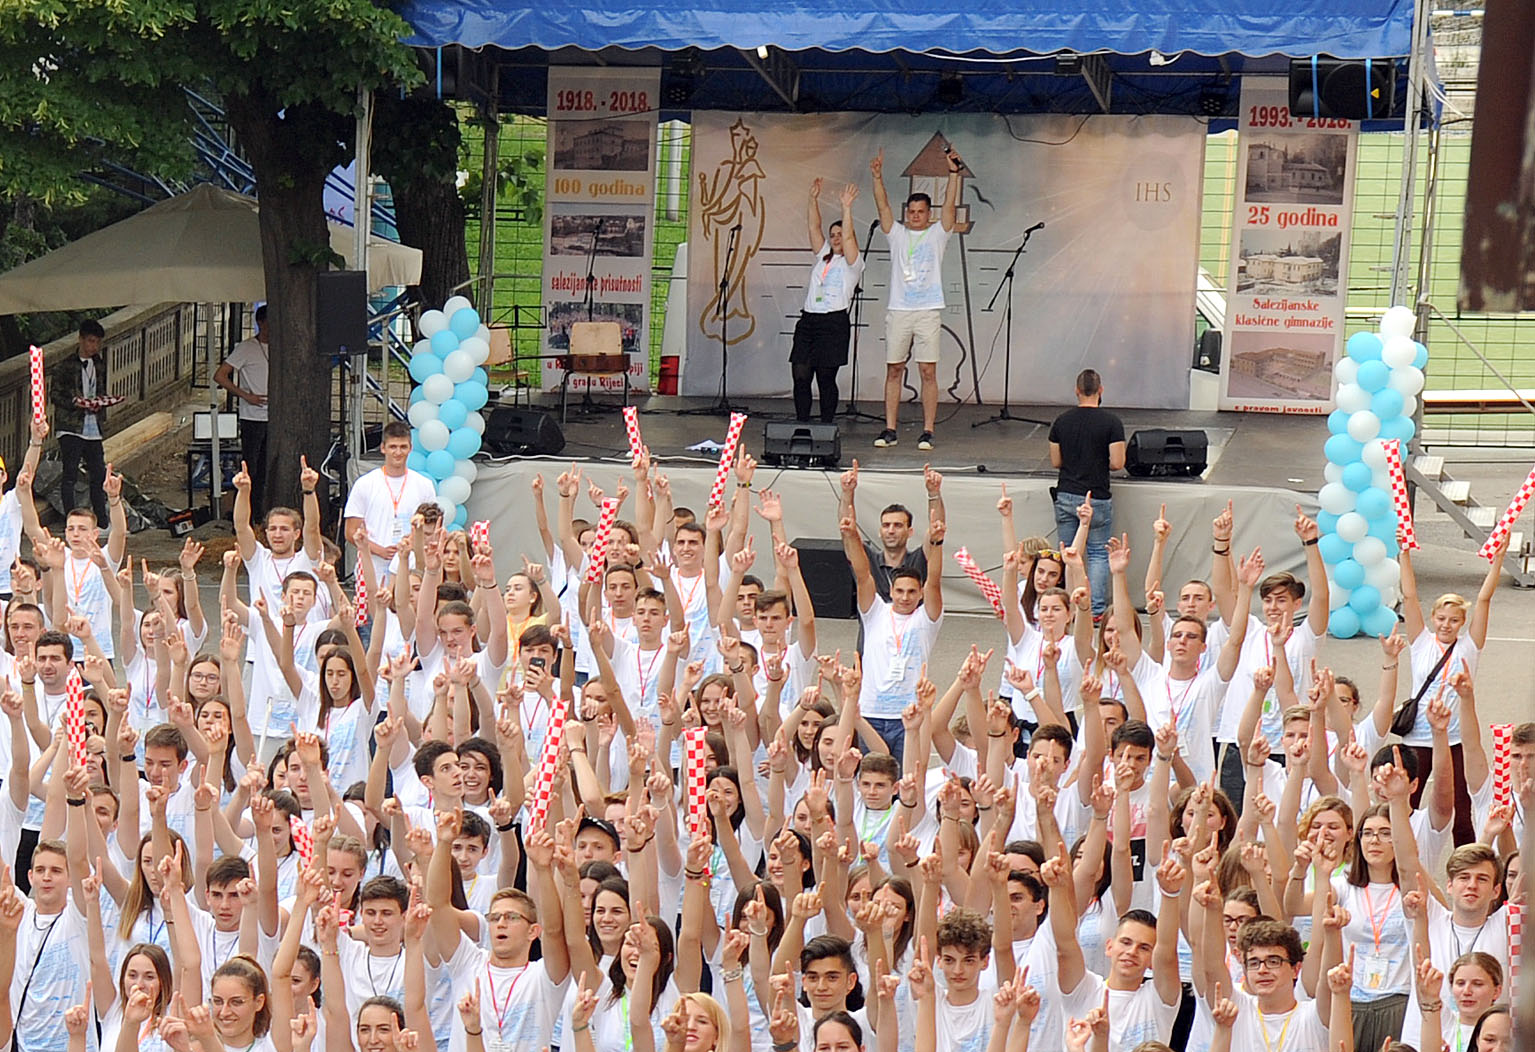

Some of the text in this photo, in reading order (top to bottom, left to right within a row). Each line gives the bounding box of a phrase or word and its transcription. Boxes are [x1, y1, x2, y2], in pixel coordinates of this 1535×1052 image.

[556, 90, 597, 111] 1918.
[609, 91, 651, 112] 2018.
[1249, 105, 1292, 127] 1993.
[554, 178, 645, 198] 100 godina
[1136, 182, 1172, 202] IHS
[1248, 206, 1338, 230] 25 godina
[600, 273, 642, 297] prisutnosti
[1252, 298, 1320, 312] Salezijanske
[1284, 316, 1334, 329] gimnazije
[573, 378, 597, 389] grau
